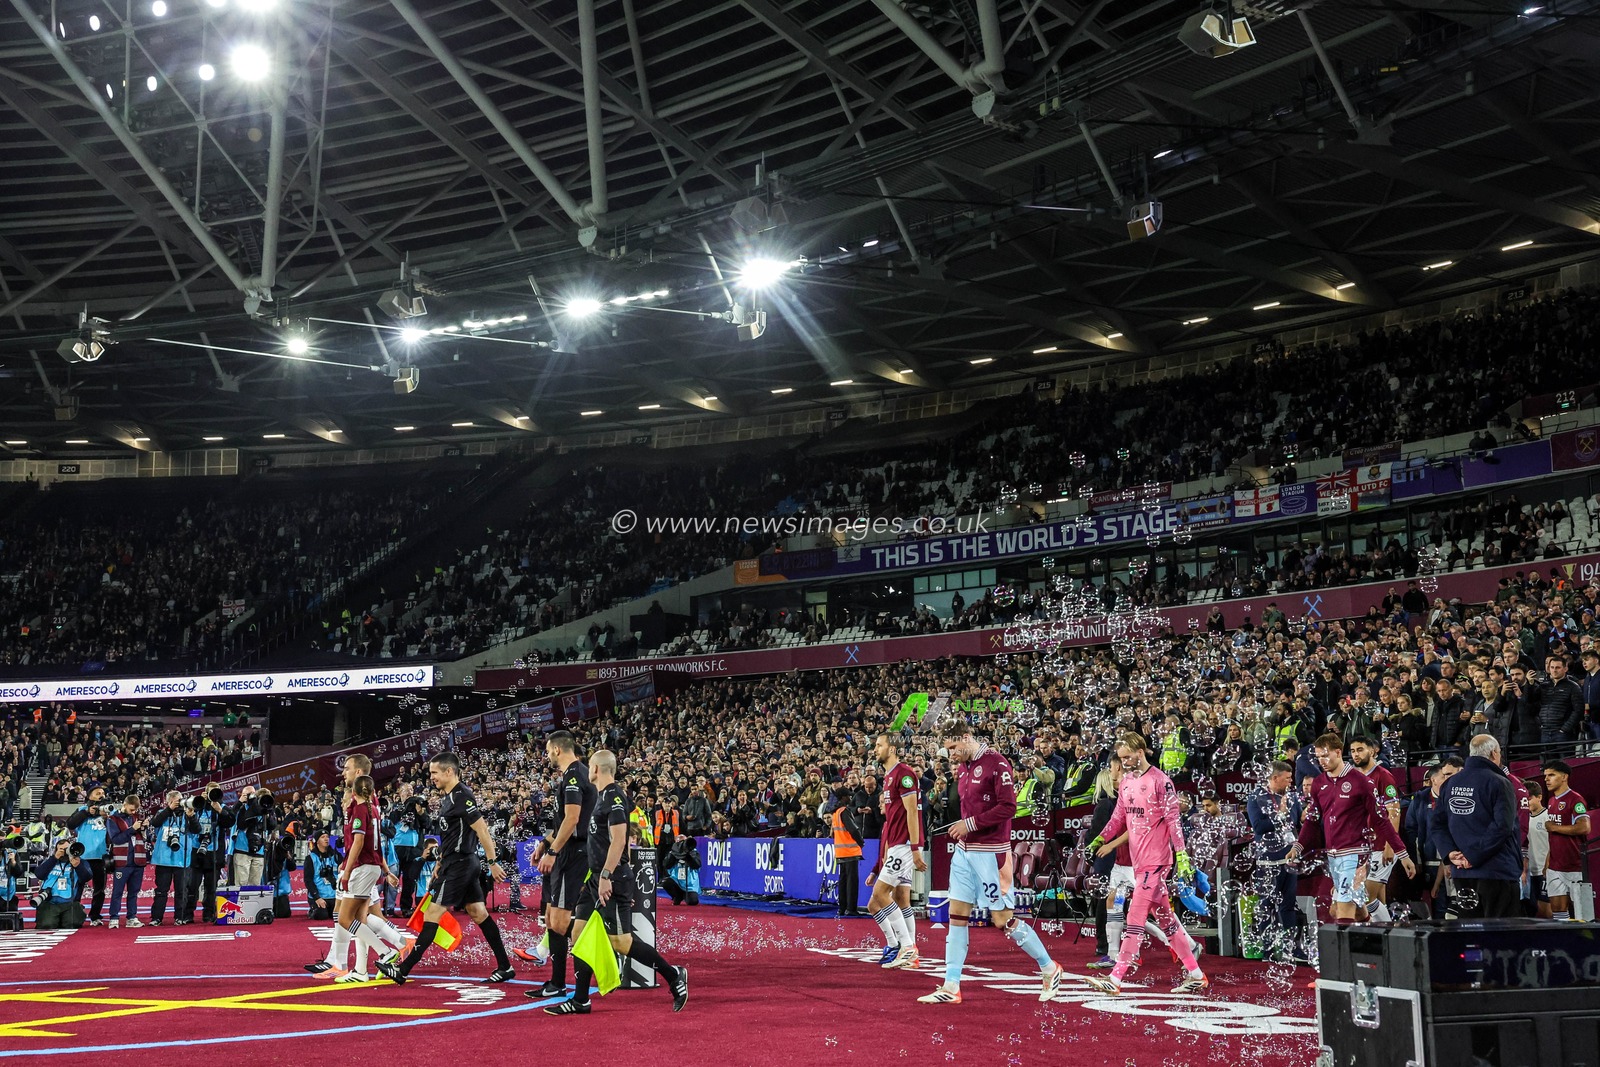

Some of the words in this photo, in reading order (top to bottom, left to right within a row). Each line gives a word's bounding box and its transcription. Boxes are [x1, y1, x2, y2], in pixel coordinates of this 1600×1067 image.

[1555, 390, 1576, 404] 212
[1282, 443, 1299, 455] 213
[61, 465, 76, 473] 220
[1281, 485, 1305, 493] LONDON
[1281, 489, 1306, 498] STADIUM
[1342, 485, 1360, 496] HAM
[1361, 482, 1377, 492] UTD
[1378, 479, 1390, 489] FC
[871, 543, 919, 571] THIS
[924, 541, 945, 566] IS
[948, 535, 991, 562] THE
[995, 522, 1097, 557] WORLD'S
[1102, 507, 1178, 542] STAGE
[53, 616, 67, 625] 219
[599, 667, 617, 679] 1895
[619, 664, 654, 678] THAMES
[656, 660, 710, 673] IRONWORKS
[711, 659, 728, 672] F.C.
[55, 685, 108, 697] AMERESCO
[133, 682, 186, 694] AMERESCO
[211, 679, 263, 691] AMERESCO
[287, 676, 339, 688] AMERESCO
[363, 672, 414, 685] AMERESCO
[265, 772, 296, 785] ACADEMY
[1010, 829, 1045, 841] BOYLE
[707, 841, 731, 868] BOYLE
[884, 855, 903, 871] 28
[1371, 860, 1379, 872] 3
[713, 871, 731, 888] SPORTS
[764, 875, 784, 893] SPORTS
[1143, 871, 1150, 884] 1
[982, 882, 999, 898] 22
[240, 916, 254, 924] Bull
